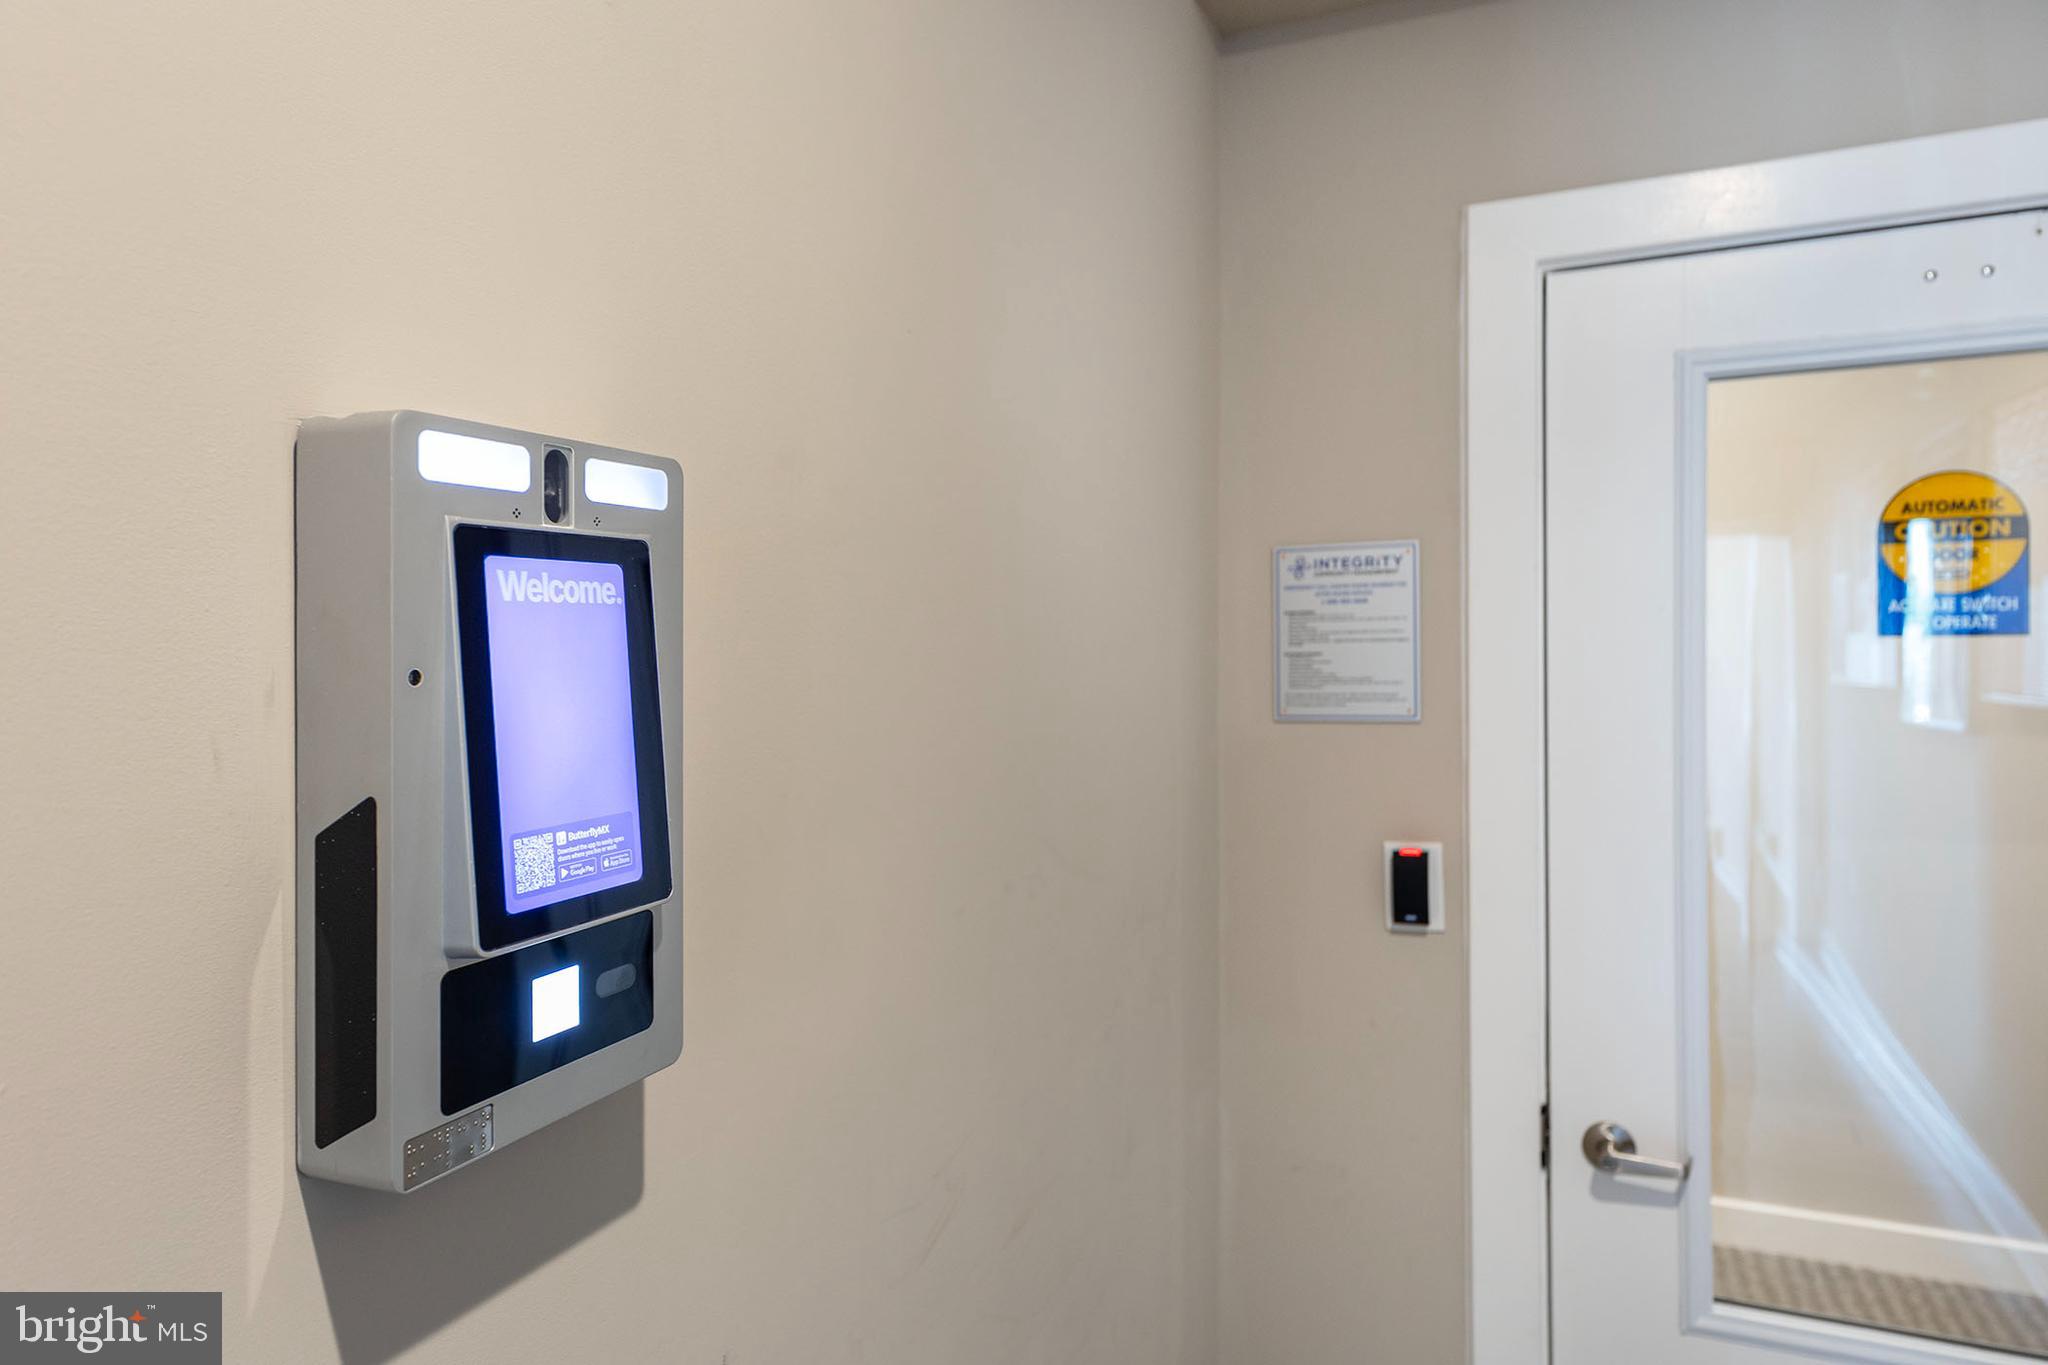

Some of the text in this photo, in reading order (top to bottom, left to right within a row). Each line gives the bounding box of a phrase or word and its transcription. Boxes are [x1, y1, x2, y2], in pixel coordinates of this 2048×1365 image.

[1902, 497, 2005, 515] AUTOMATIC
[1894, 518, 2012, 541] CUTION
[496, 569, 622, 605] Welcome.
[1888, 595, 2019, 613] ACATE SWITCH
[1932, 614, 1998, 630] OPERATE
[568, 824, 610, 841] ButterflyMX
